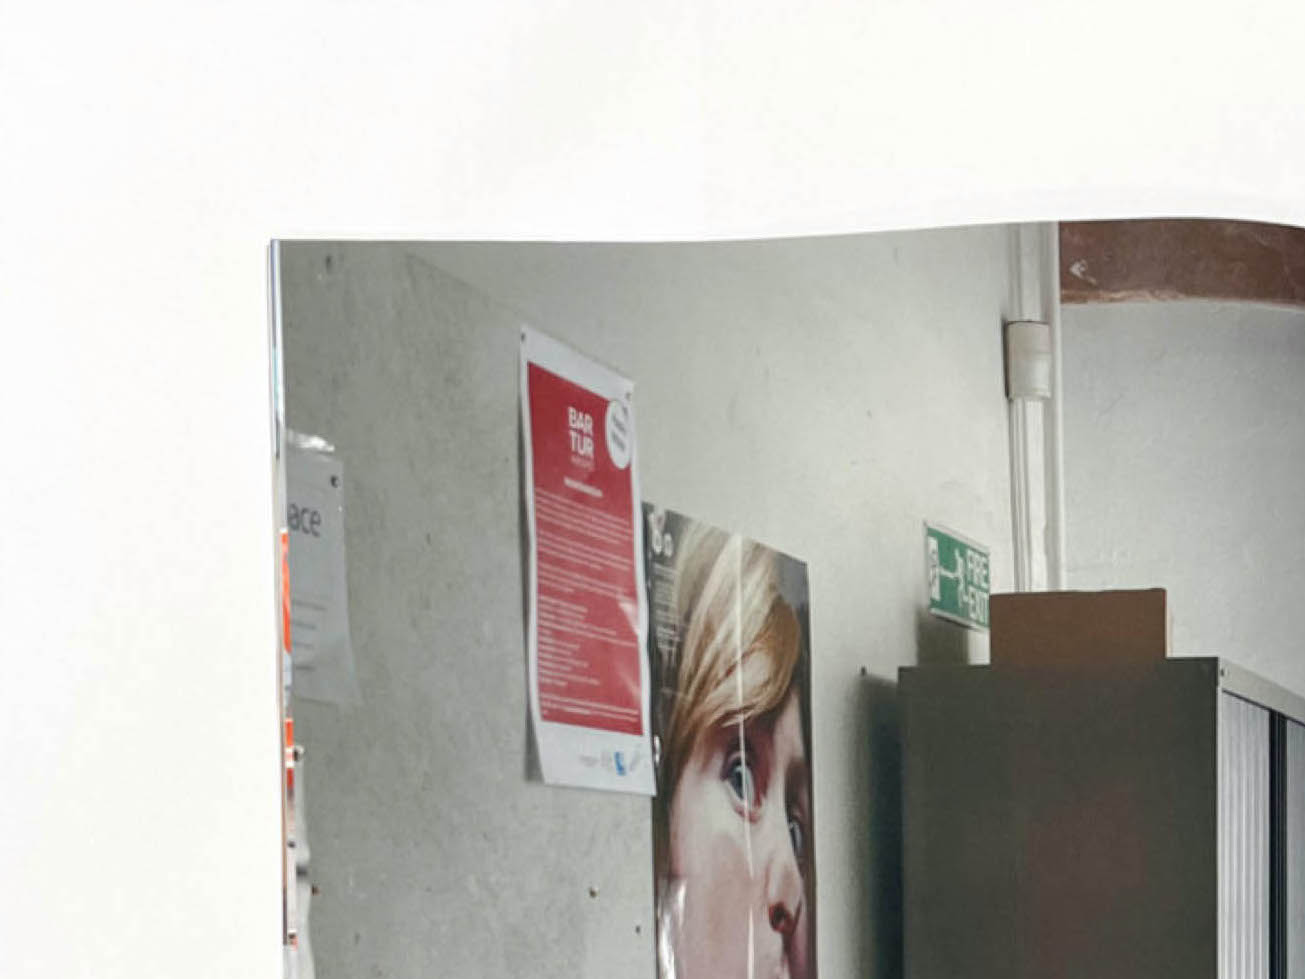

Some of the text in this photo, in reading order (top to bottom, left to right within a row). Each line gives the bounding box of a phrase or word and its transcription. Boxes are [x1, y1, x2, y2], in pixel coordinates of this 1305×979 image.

[567, 406, 593, 434] BAR
[569, 429, 595, 457] TUR
[967, 549, 989, 588] FIRE
